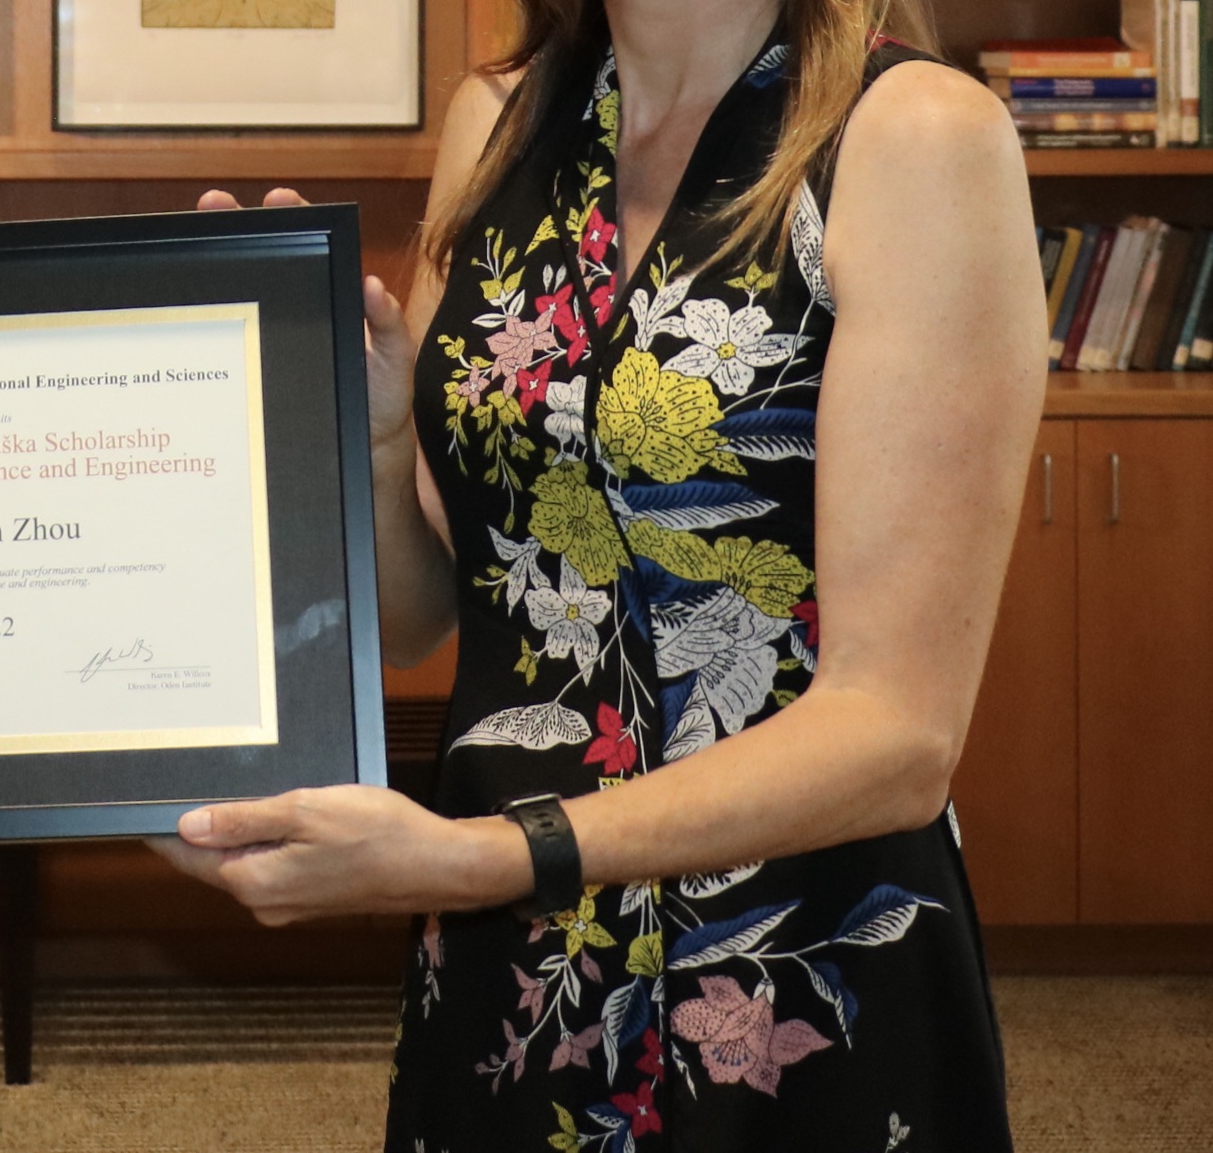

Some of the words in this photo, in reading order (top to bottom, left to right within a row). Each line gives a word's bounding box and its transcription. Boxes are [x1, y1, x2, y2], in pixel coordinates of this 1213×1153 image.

[35, 372, 127, 390] Engineering
[133, 370, 161, 384] and
[166, 368, 229, 383] Sciences
[1, 413, 12, 424] its
[44, 428, 171, 452] Scholarship
[39, 458, 77, 479] and
[85, 453, 217, 481] Engineering
[12, 517, 82, 541] Zhou
[21, 566, 84, 580] performance
[87, 564, 106, 575] and
[107, 562, 167, 574] competency
[8, 577, 27, 590] and
[29, 576, 91, 589] engineering.
[150, 670, 172, 679] Karen
[160, 681, 180, 689] Oden
[182, 681, 211, 689] Institute
